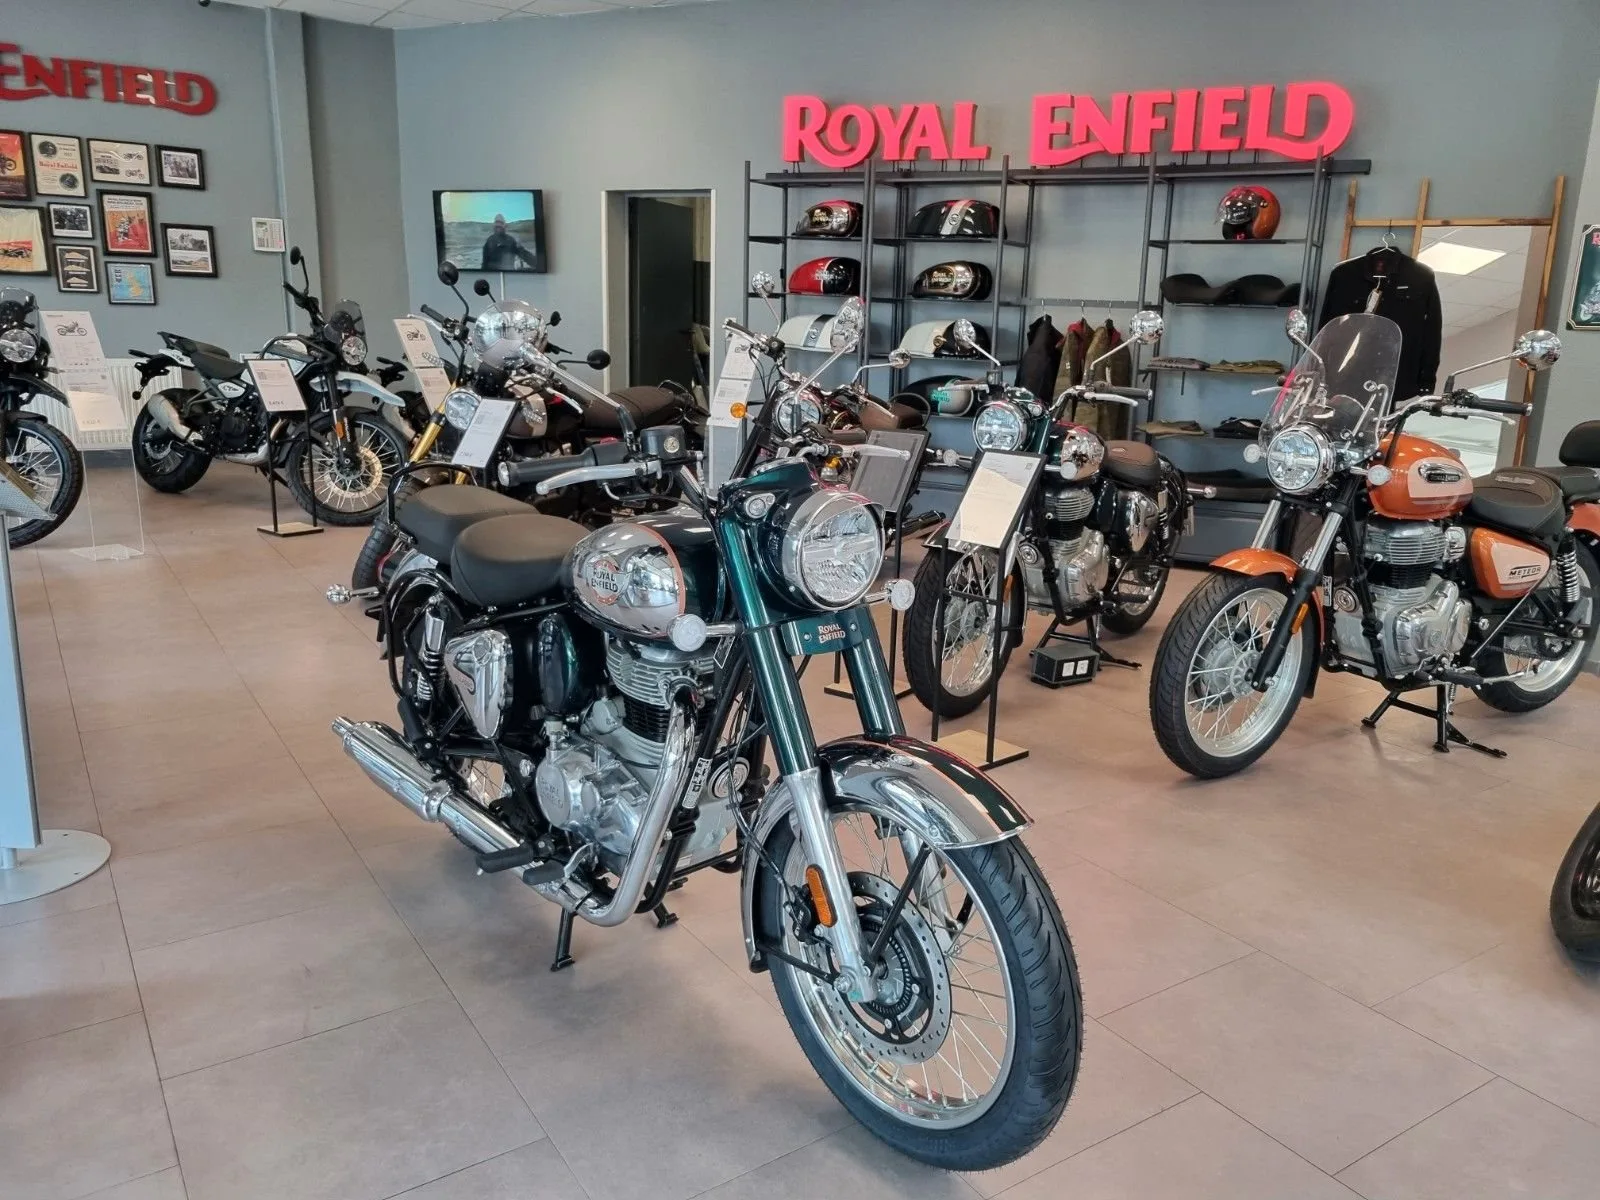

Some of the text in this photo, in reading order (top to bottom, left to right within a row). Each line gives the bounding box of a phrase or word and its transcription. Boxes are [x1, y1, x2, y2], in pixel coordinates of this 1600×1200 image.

[783, 82, 1355, 168] ROYAL ENFIELD
[593, 567, 615, 582] ROYAL
[1509, 567, 1541, 576] METEOR
[591, 578, 619, 593] ENFIELD
[818, 623, 841, 634] ROYAL
[818, 630, 846, 643] ENFIELD
